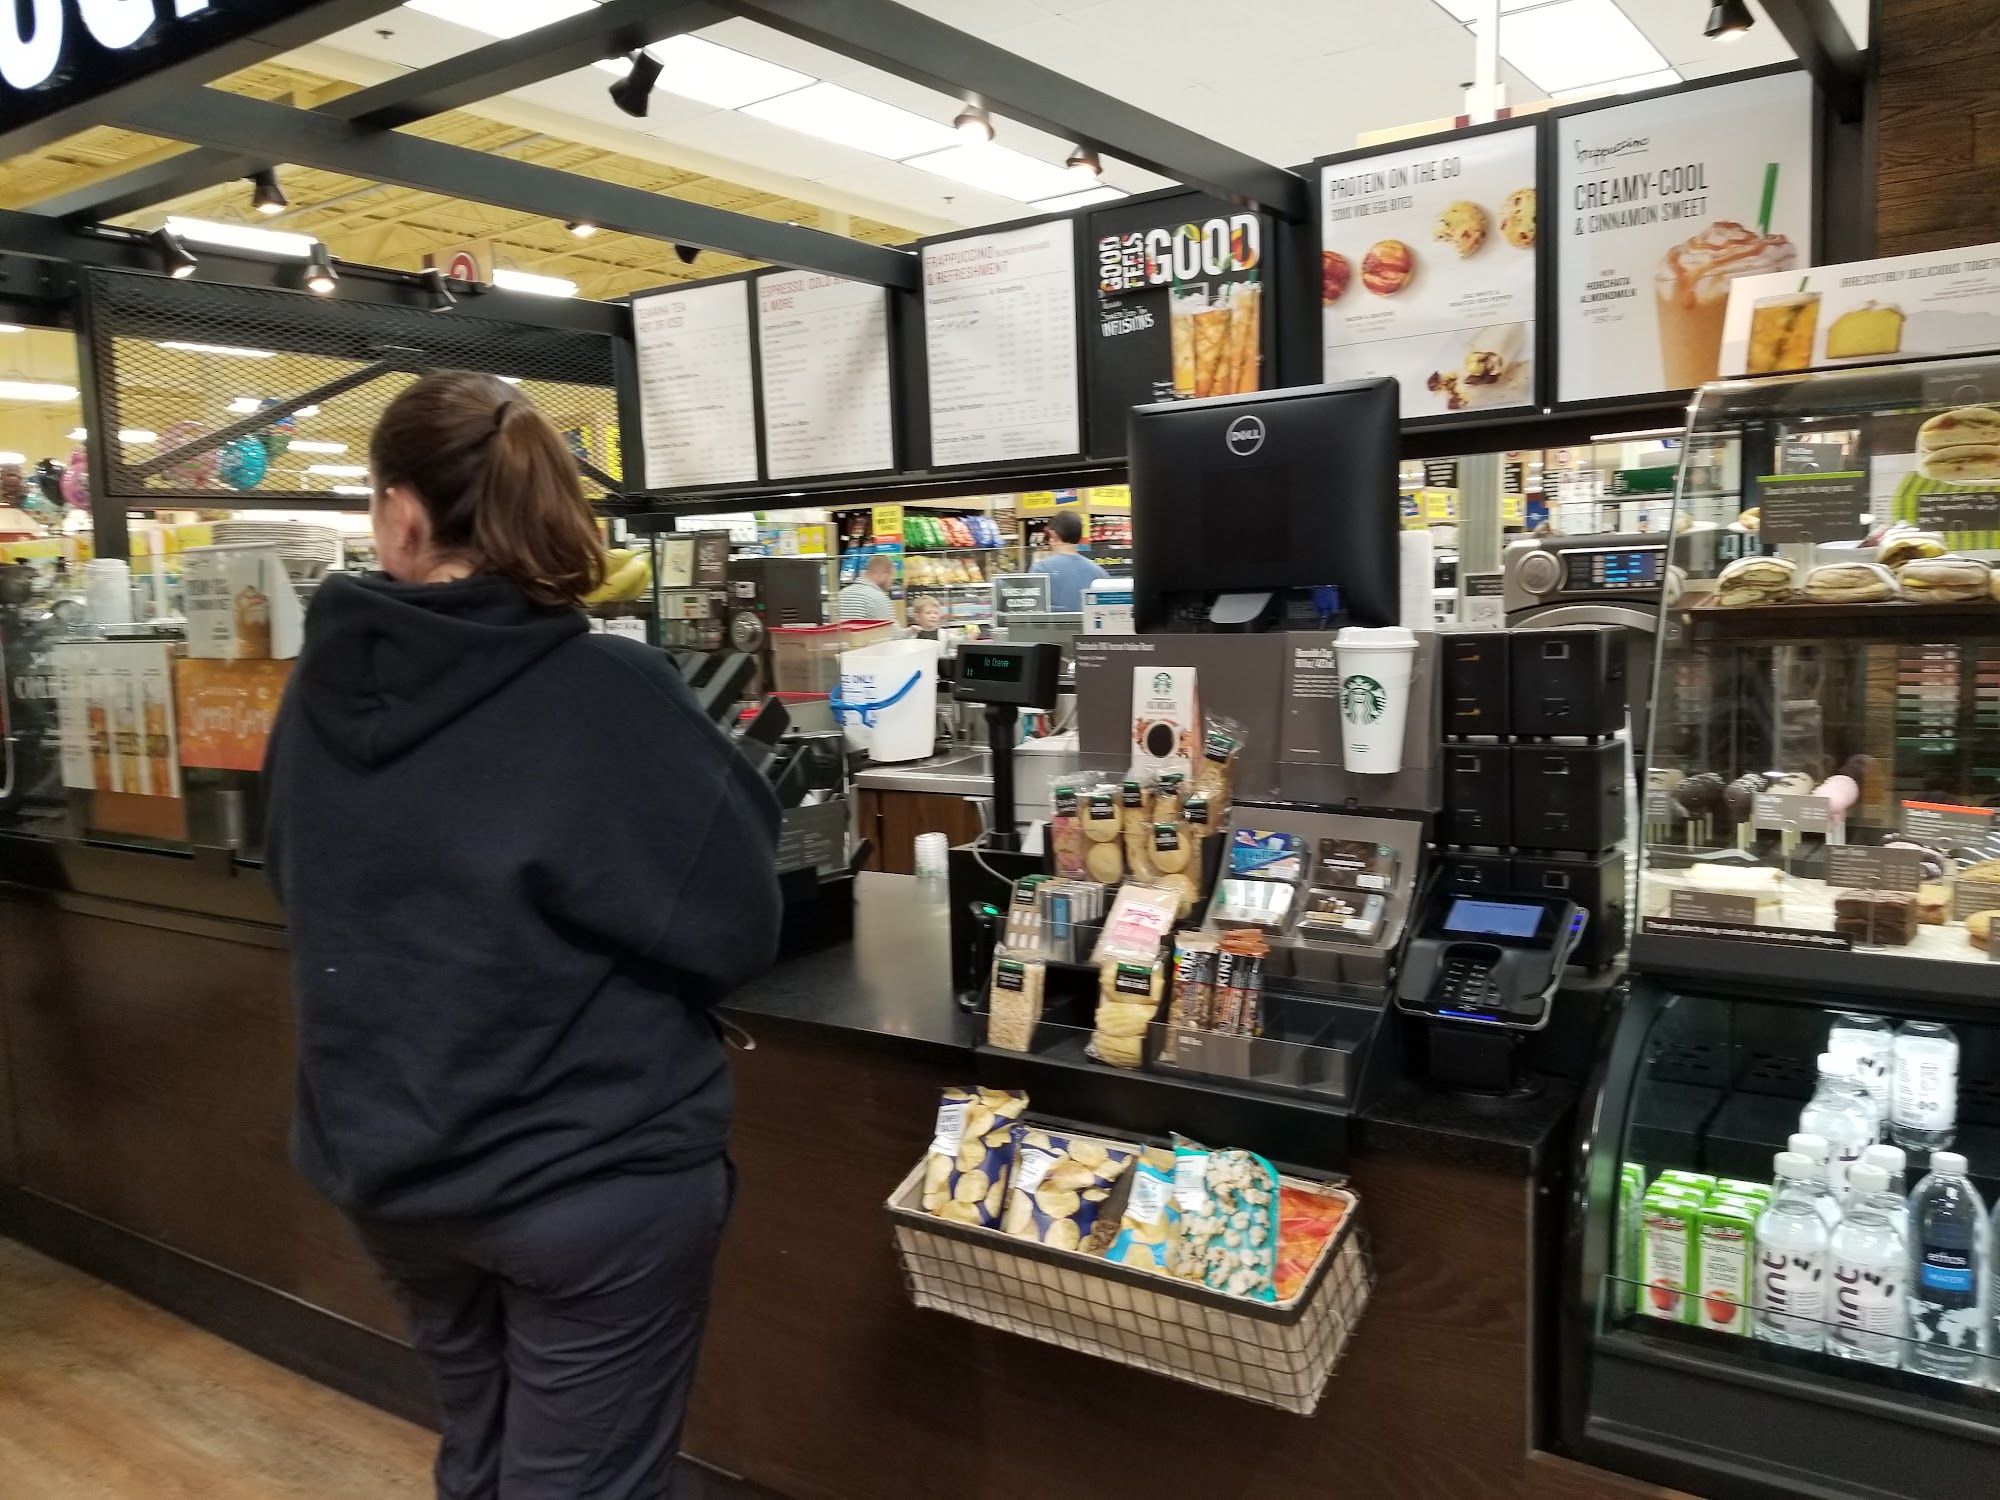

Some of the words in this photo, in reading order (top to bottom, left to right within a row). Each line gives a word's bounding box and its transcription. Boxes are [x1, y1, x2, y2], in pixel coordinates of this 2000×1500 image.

[1330, 171, 1386, 199] PROTEIN
[1388, 167, 1409, 189] ON
[1413, 160, 1438, 185] THE
[1441, 156, 1461, 180] GO
[1574, 163, 1709, 210] CREAMY-COOL
[1391, 195, 1413, 211] BITES
[1575, 217, 1585, 236] &
[1588, 205, 1659, 233] CINNAMON
[1662, 197, 1708, 222] SWEET
[1099, 236, 1123, 291] GOOD
[1121, 232, 1145, 289] FEELS
[1144, 213, 1261, 285] GOOD
[760, 279, 805, 298] ESPRESSO
[769, 296, 795, 311] MORE
[1230, 430, 1261, 441] DELL
[984, 658, 991, 667] No
[991, 658, 1010, 668] Change
[1177, 950, 1196, 982] KIND
[1216, 952, 1234, 988] KIND
[1761, 1251, 1787, 1331] hint
[1834, 1265, 1862, 1347] hint
